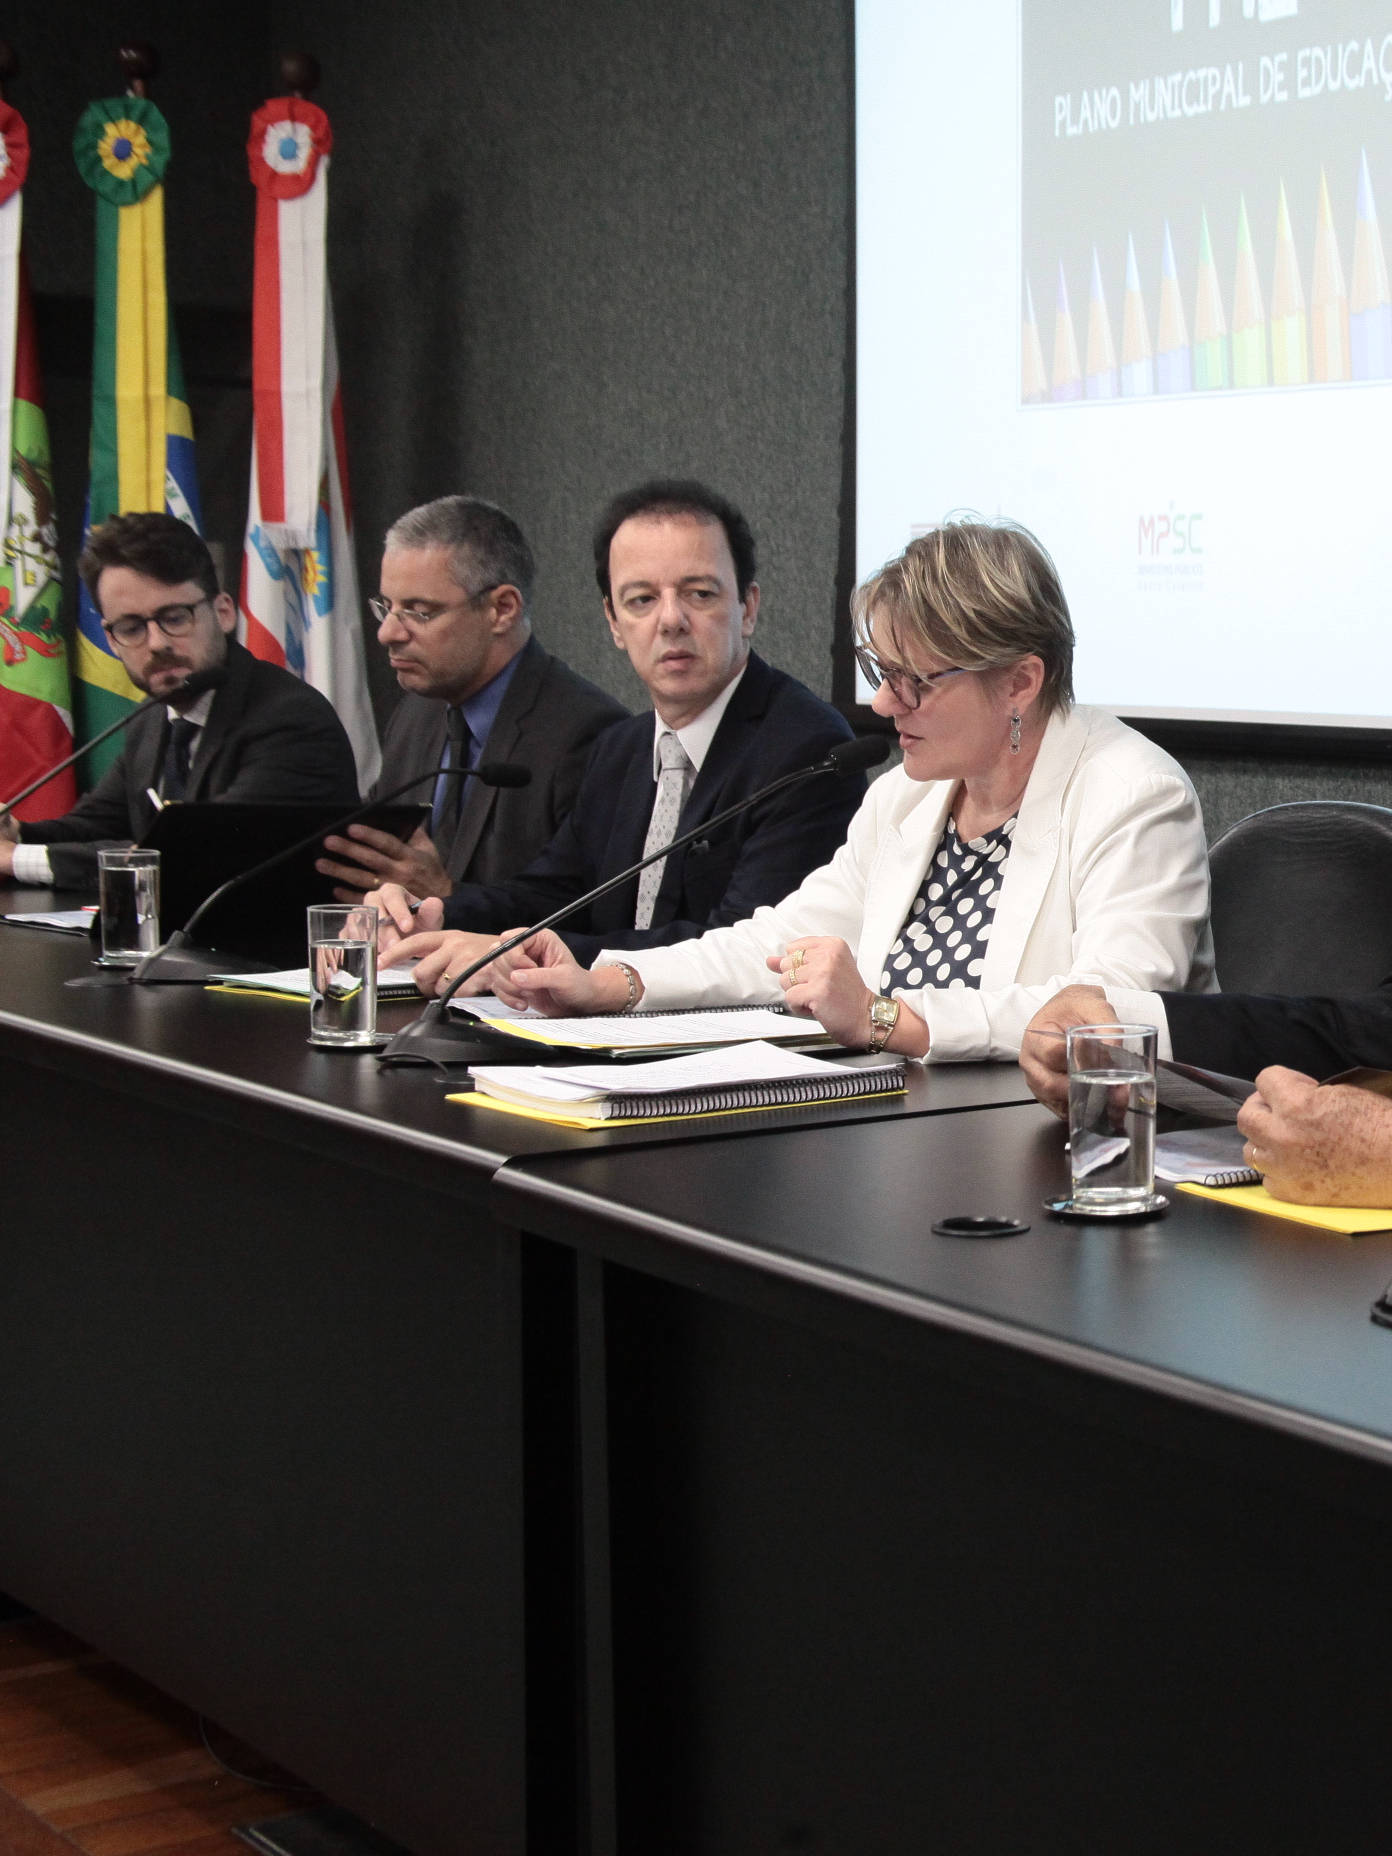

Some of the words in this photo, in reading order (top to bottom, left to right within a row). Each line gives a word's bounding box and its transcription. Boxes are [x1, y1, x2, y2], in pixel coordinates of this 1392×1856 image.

[1053, 86, 1121, 138] PLANO
[1128, 61, 1251, 126] MUNICIPAL
[1259, 51, 1289, 105] DE
[1138, 513, 1204, 555] MPSC
